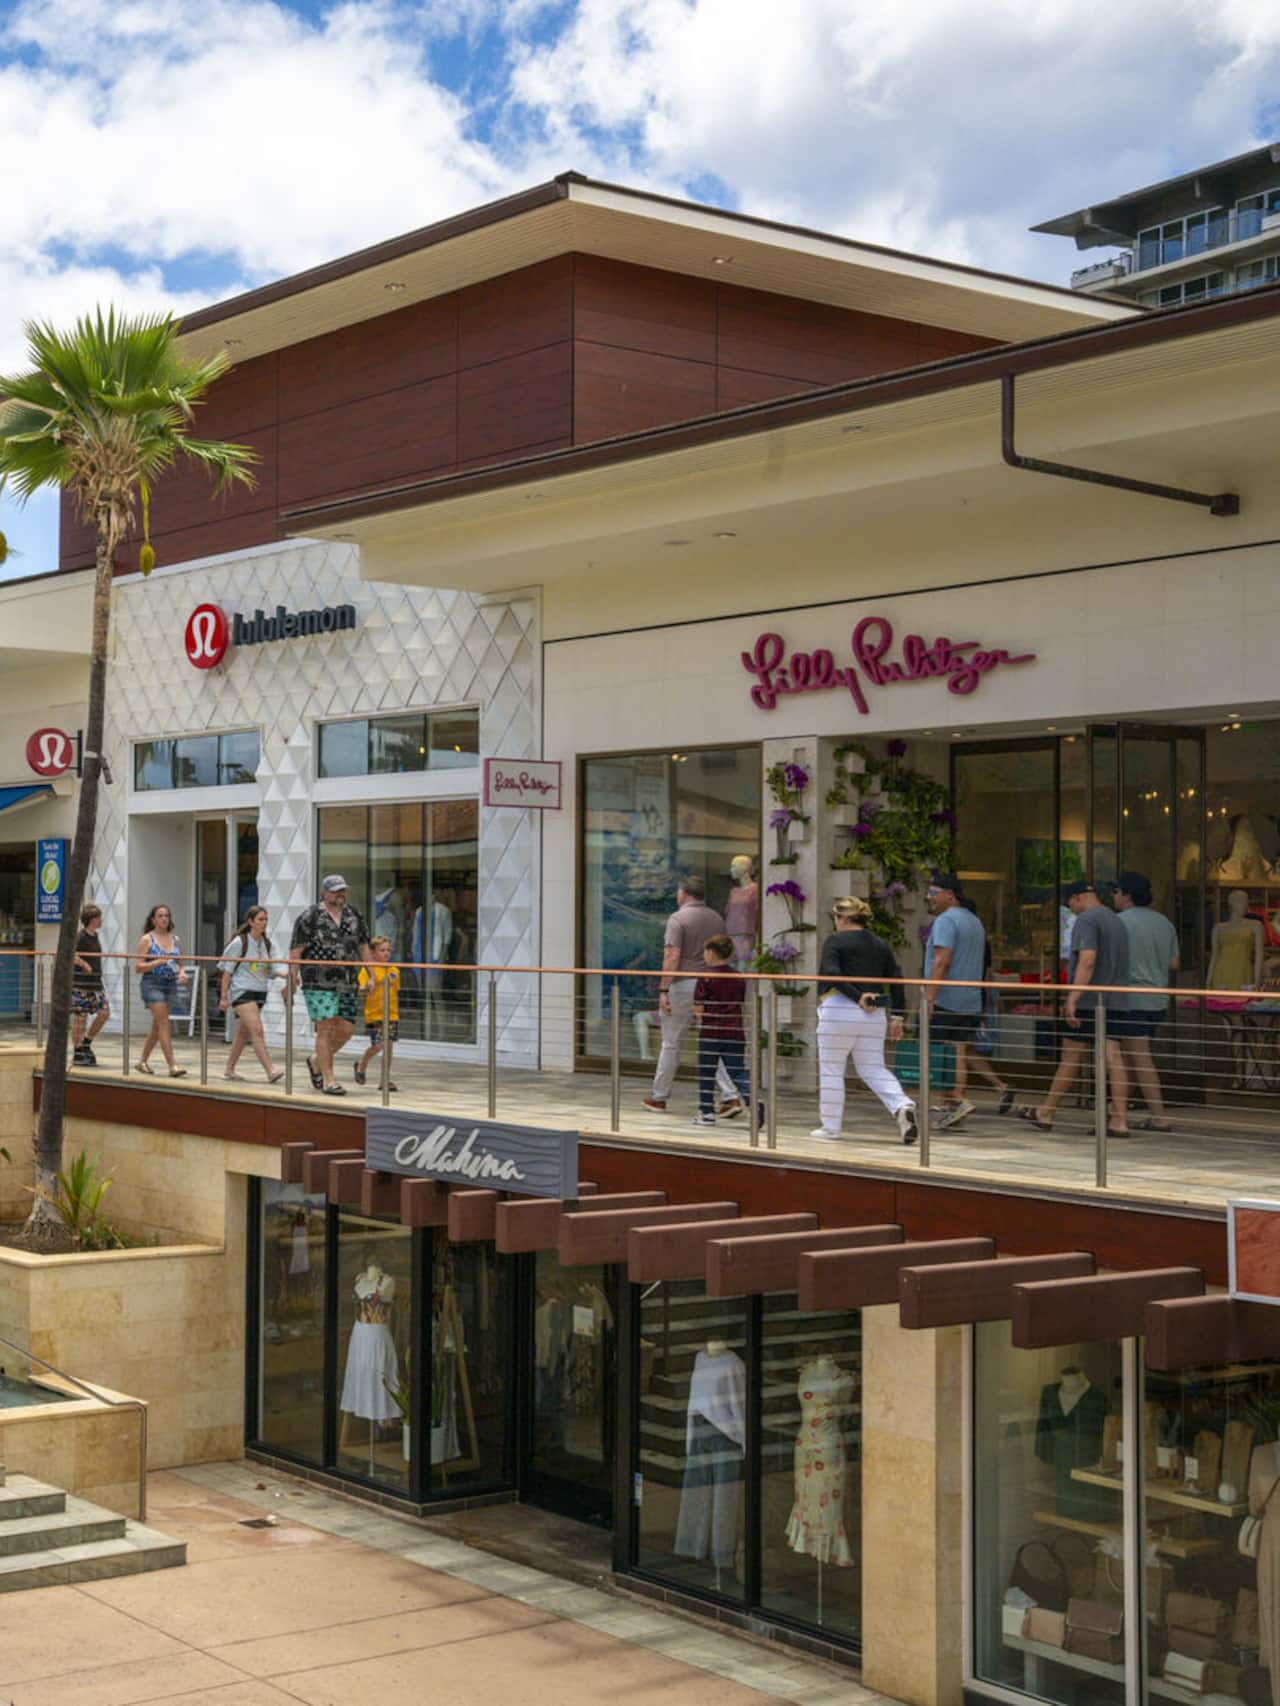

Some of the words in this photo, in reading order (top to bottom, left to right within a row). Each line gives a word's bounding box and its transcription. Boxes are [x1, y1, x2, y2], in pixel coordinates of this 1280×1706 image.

[233, 604, 356, 646] lululemon
[741, 632, 869, 714] Lilly
[852, 616, 1036, 695] Pulitzer
[394, 1125, 526, 1180] Mahina
